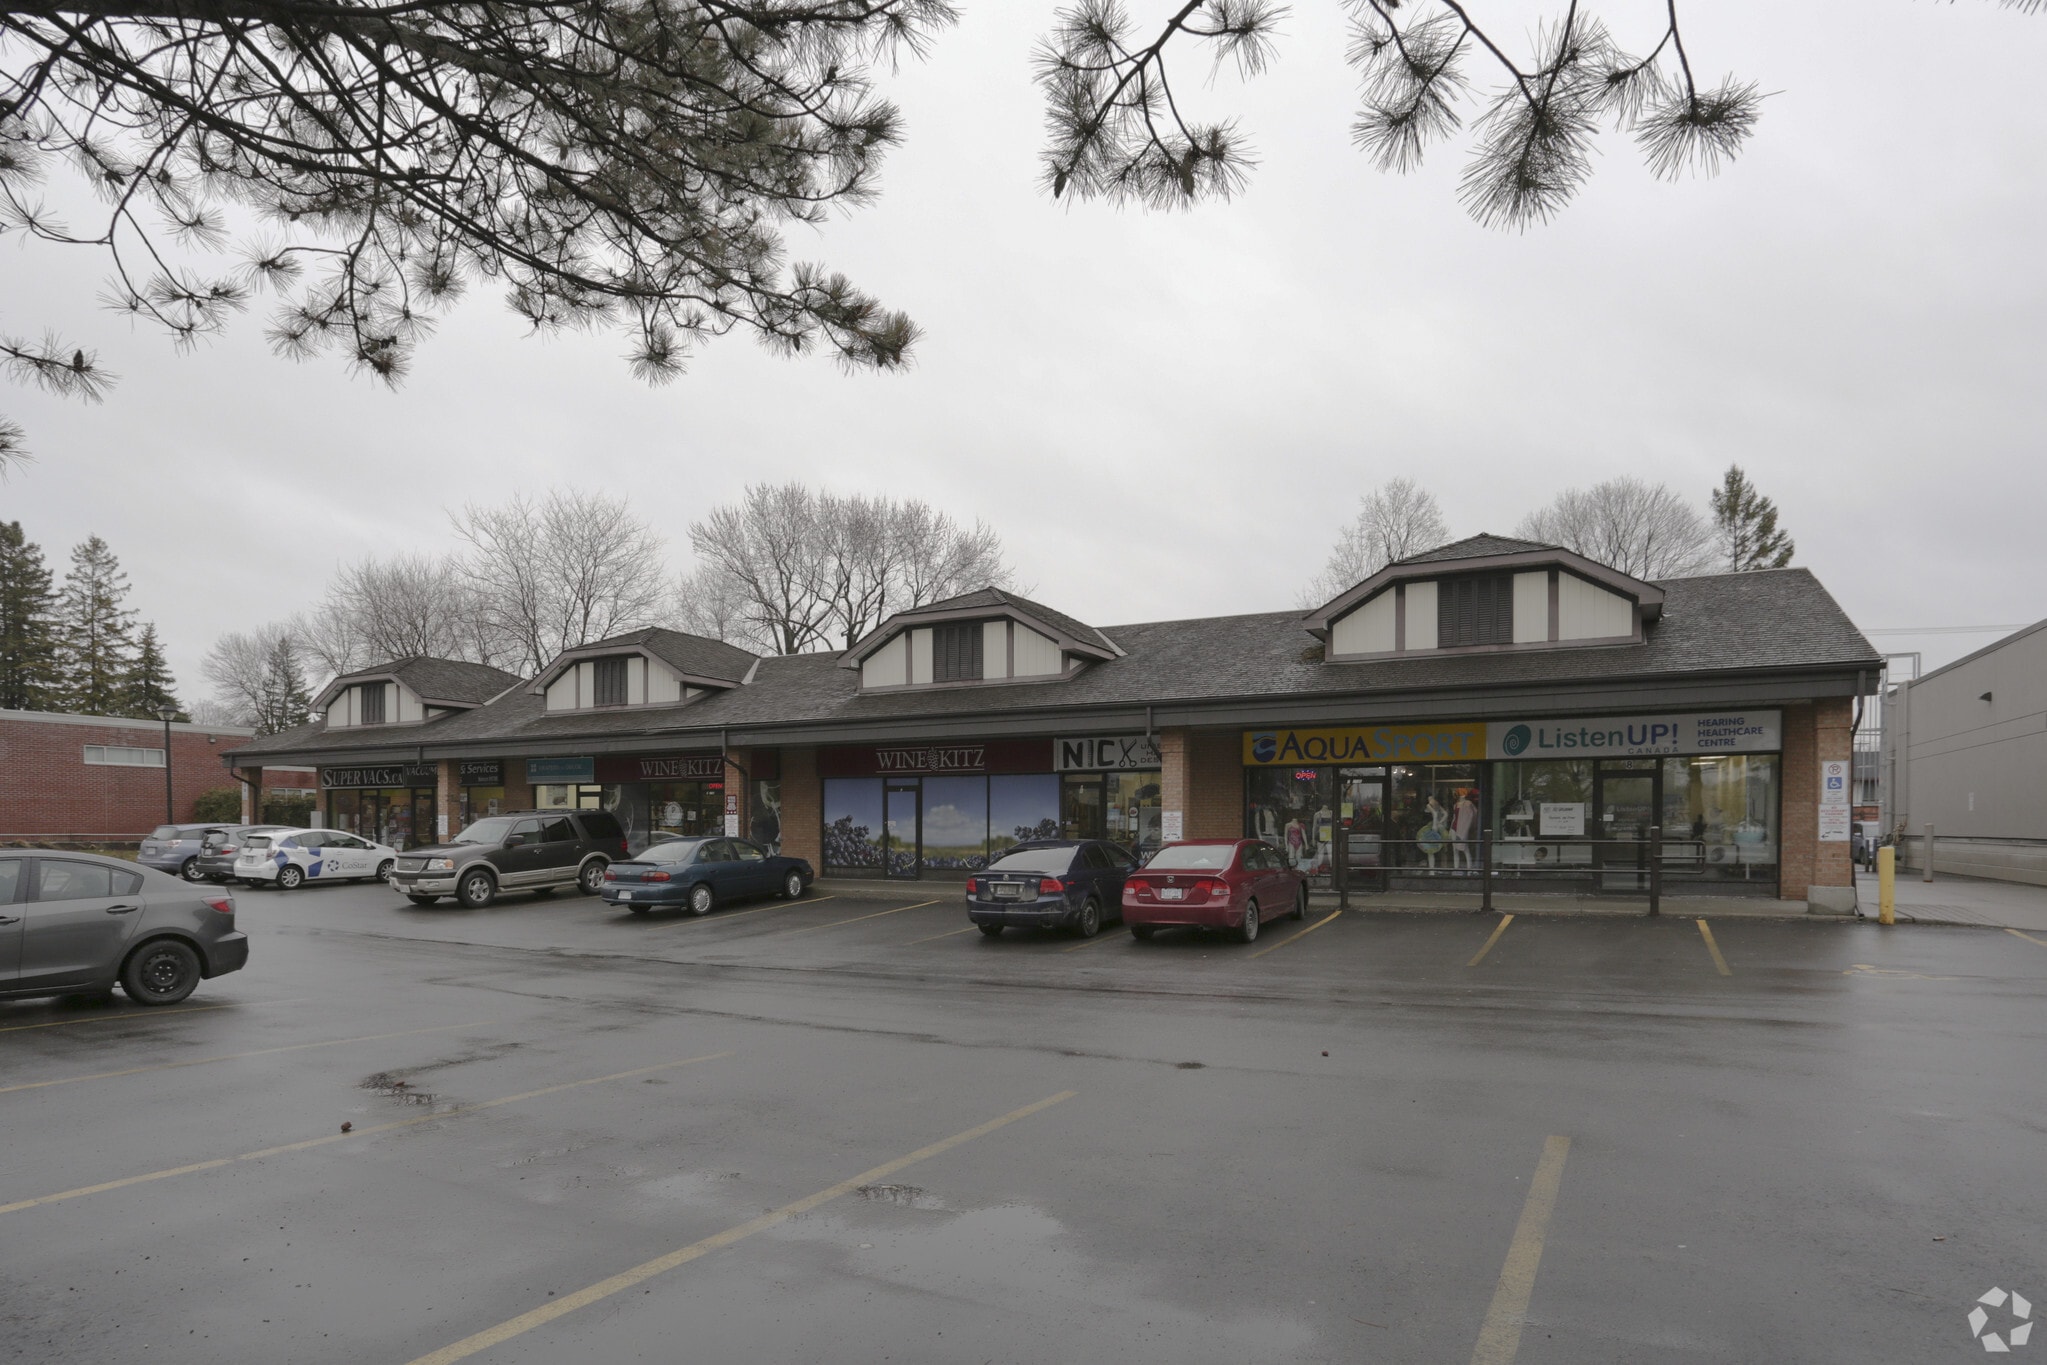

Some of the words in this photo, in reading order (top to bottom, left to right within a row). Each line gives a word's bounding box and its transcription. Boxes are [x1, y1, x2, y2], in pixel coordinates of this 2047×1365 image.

[1697, 717, 1745, 727] HEARING
[1538, 723, 1679, 748] ListenUP!
[1697, 726, 1764, 737] HEALTHCARE
[1278, 731, 1371, 761] AQUA
[1373, 728, 1475, 759] SPORT
[1697, 738, 1737, 747] CENTRE
[1627, 746, 1679, 755] CANADA
[876, 751, 928, 769] WINE
[938, 749, 985, 768] KITZ
[1625, 760, 1634, 769] 8
[466, 763, 499, 774] Services
[640, 760, 679, 776] WINE
[687, 759, 723, 775] KITZ
[322, 769, 361, 787] SUPER
[1295, 772, 1317, 780] OPEN
[342, 862, 367, 870] CoStar
